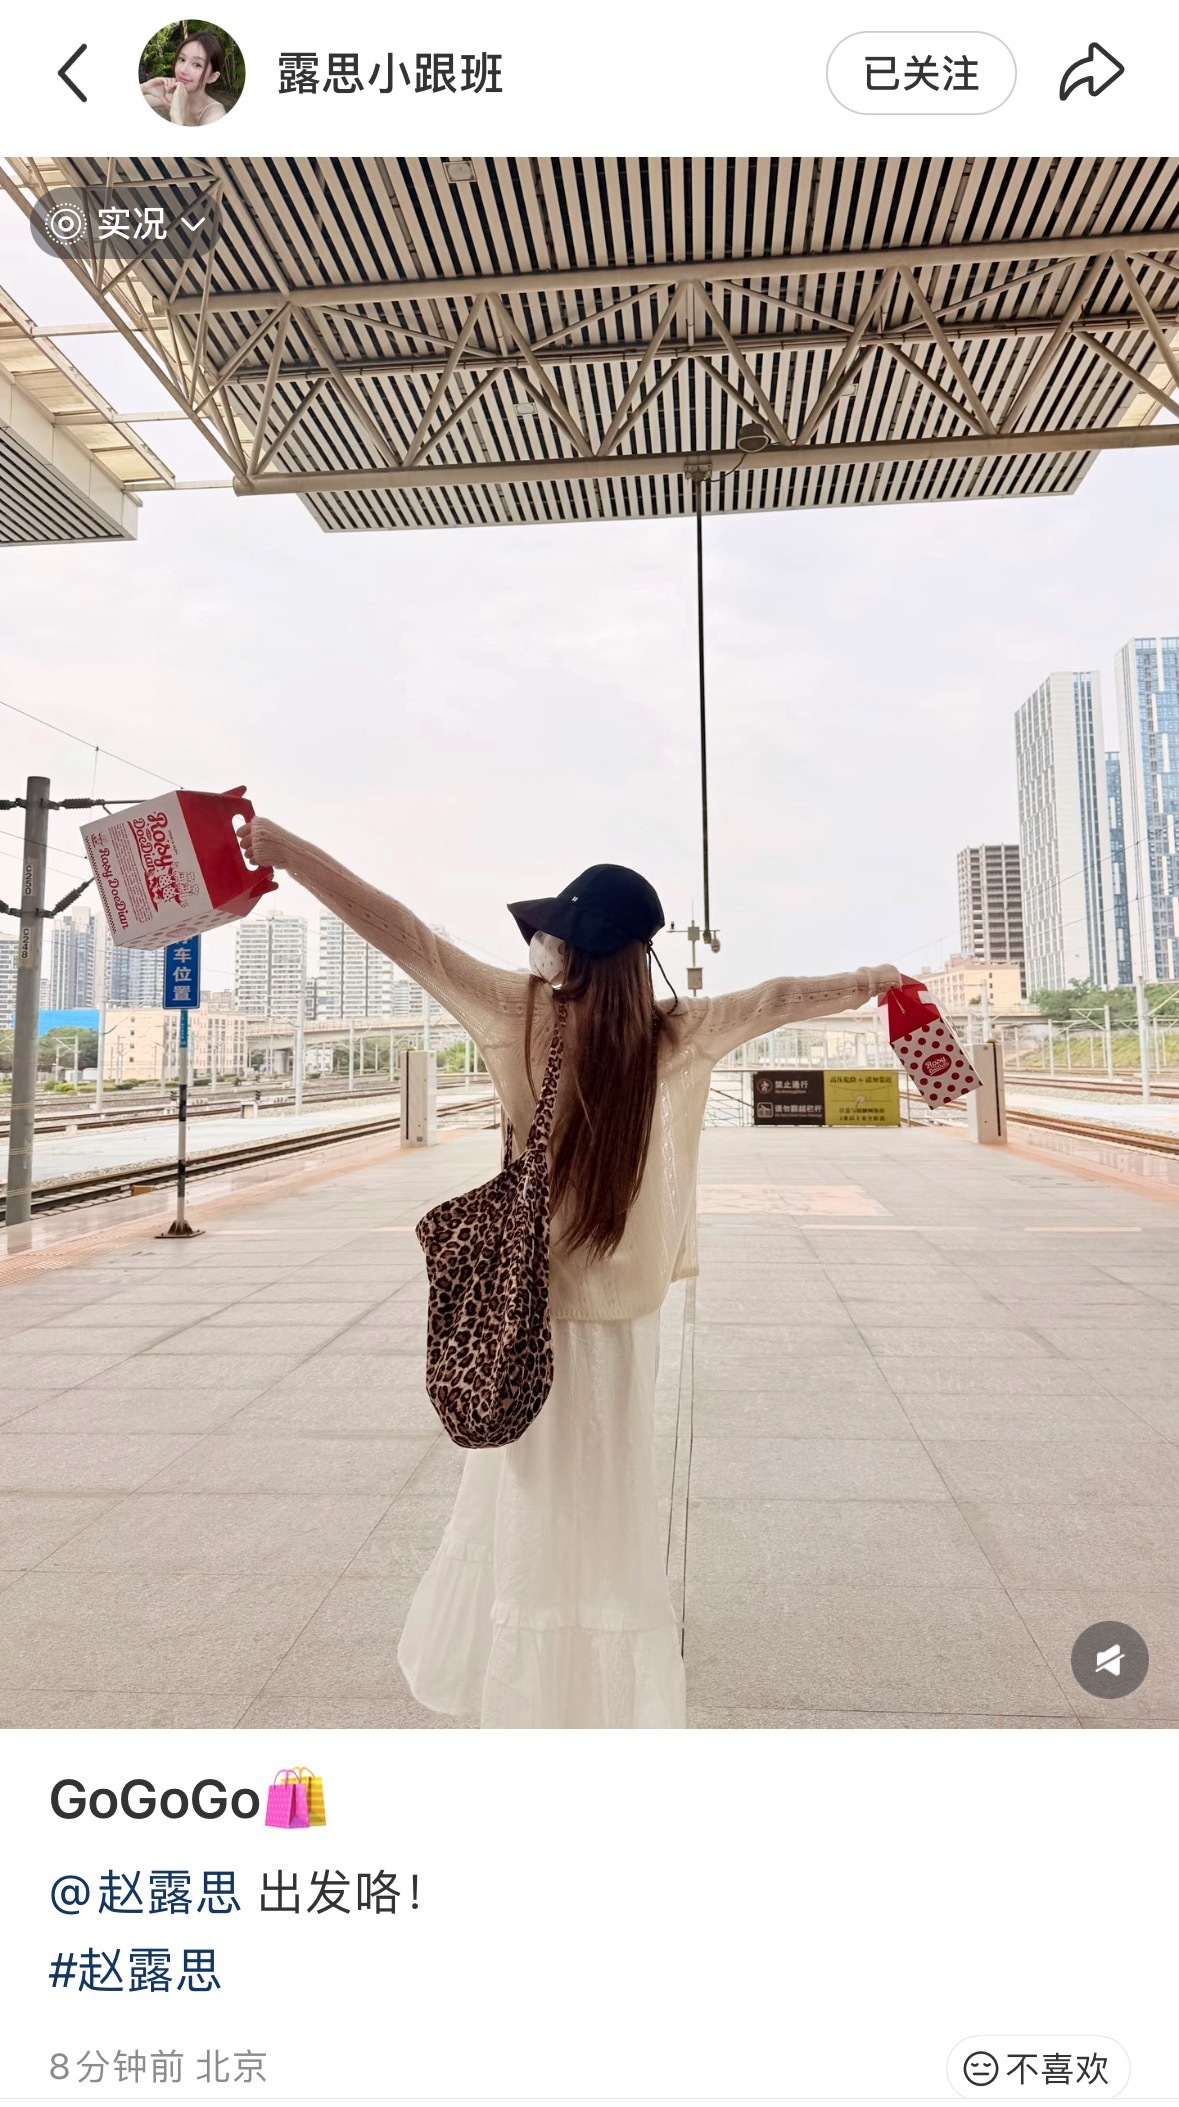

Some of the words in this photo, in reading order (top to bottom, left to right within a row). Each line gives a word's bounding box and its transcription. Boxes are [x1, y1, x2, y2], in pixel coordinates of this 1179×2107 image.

[147, 812, 173, 870] Rosy
[99, 848, 113, 879] Rosy
[108, 878, 129, 930] DoeDian
[21, 928, 29, 958] C248
[172, 938, 192, 1001] 车位置
[775, 1080, 808, 1089] 禁止通行
